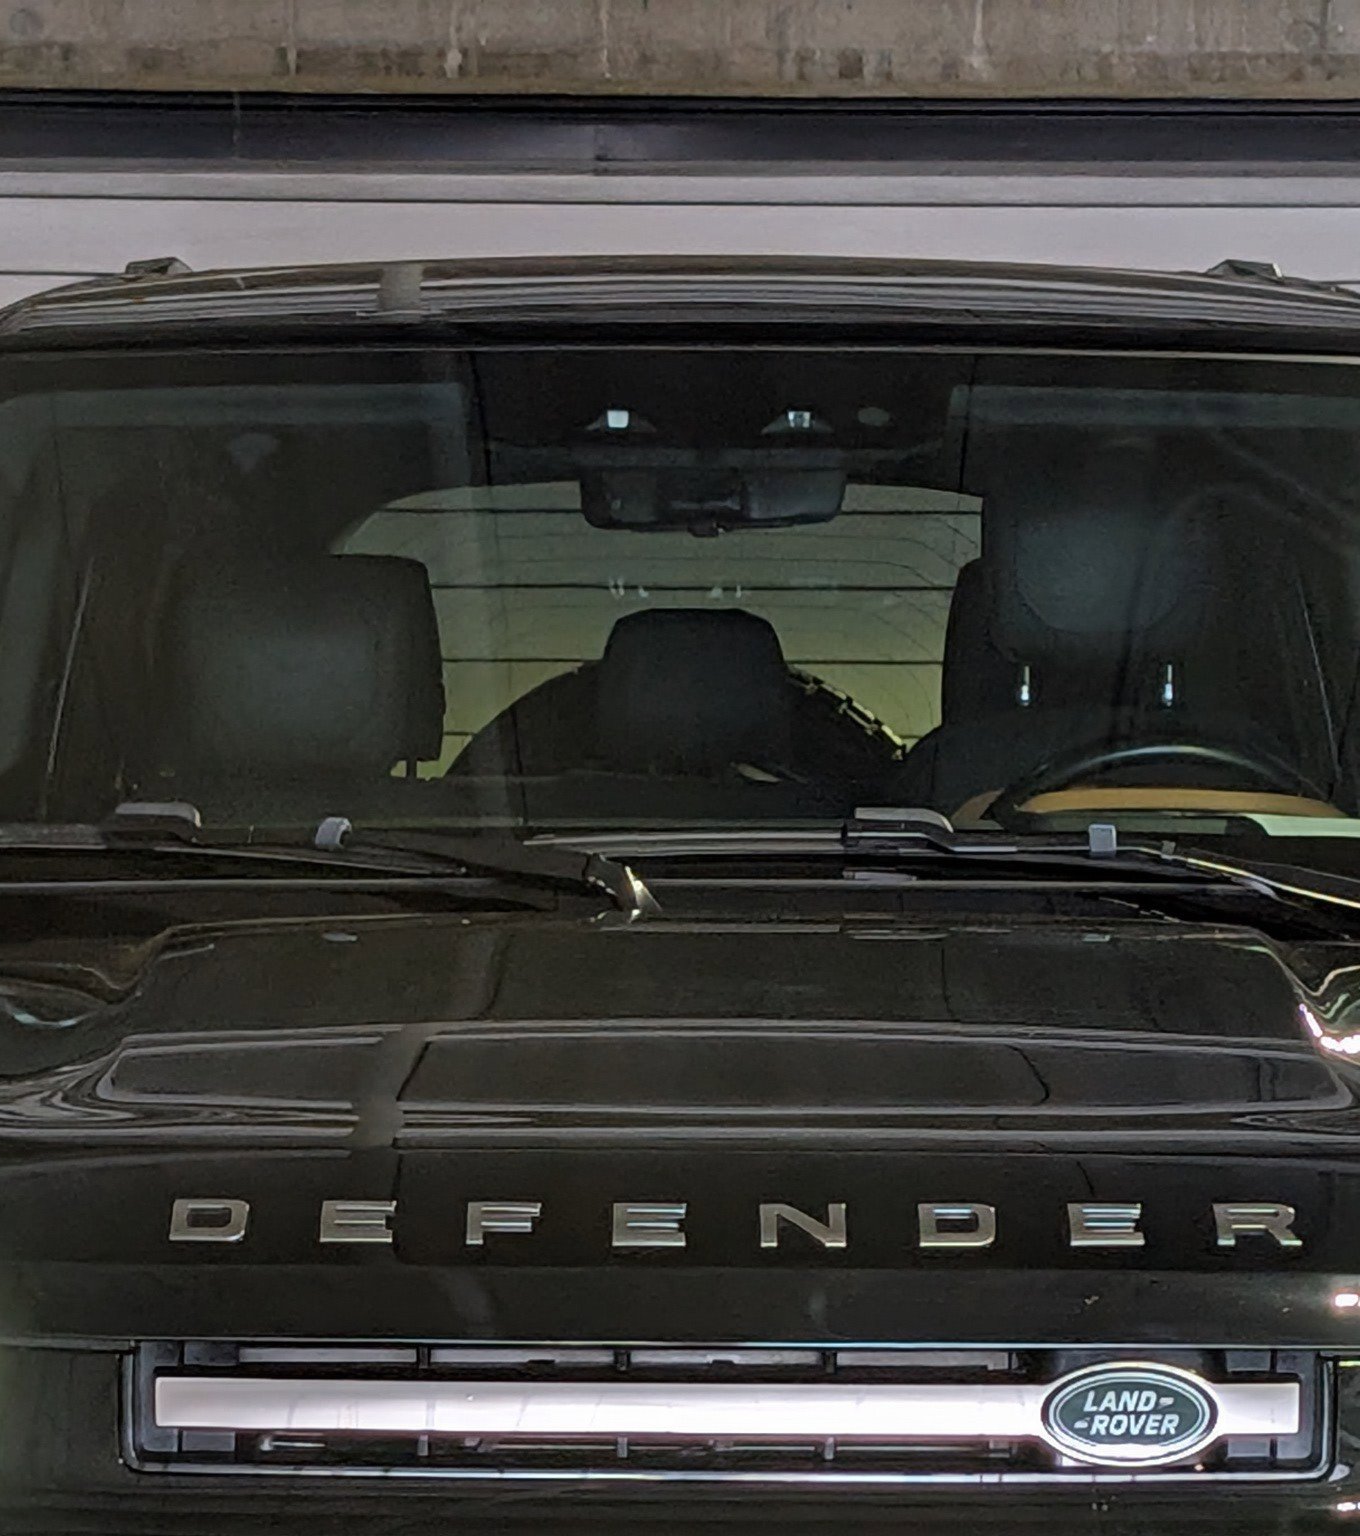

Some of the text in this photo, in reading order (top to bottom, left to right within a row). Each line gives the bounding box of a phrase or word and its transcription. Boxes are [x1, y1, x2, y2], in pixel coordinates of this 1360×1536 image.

[168, 1199, 1303, 1249] DEFENDER
[1083, 1390, 1158, 1412] LAND
[1089, 1413, 1180, 1436] ROVER
